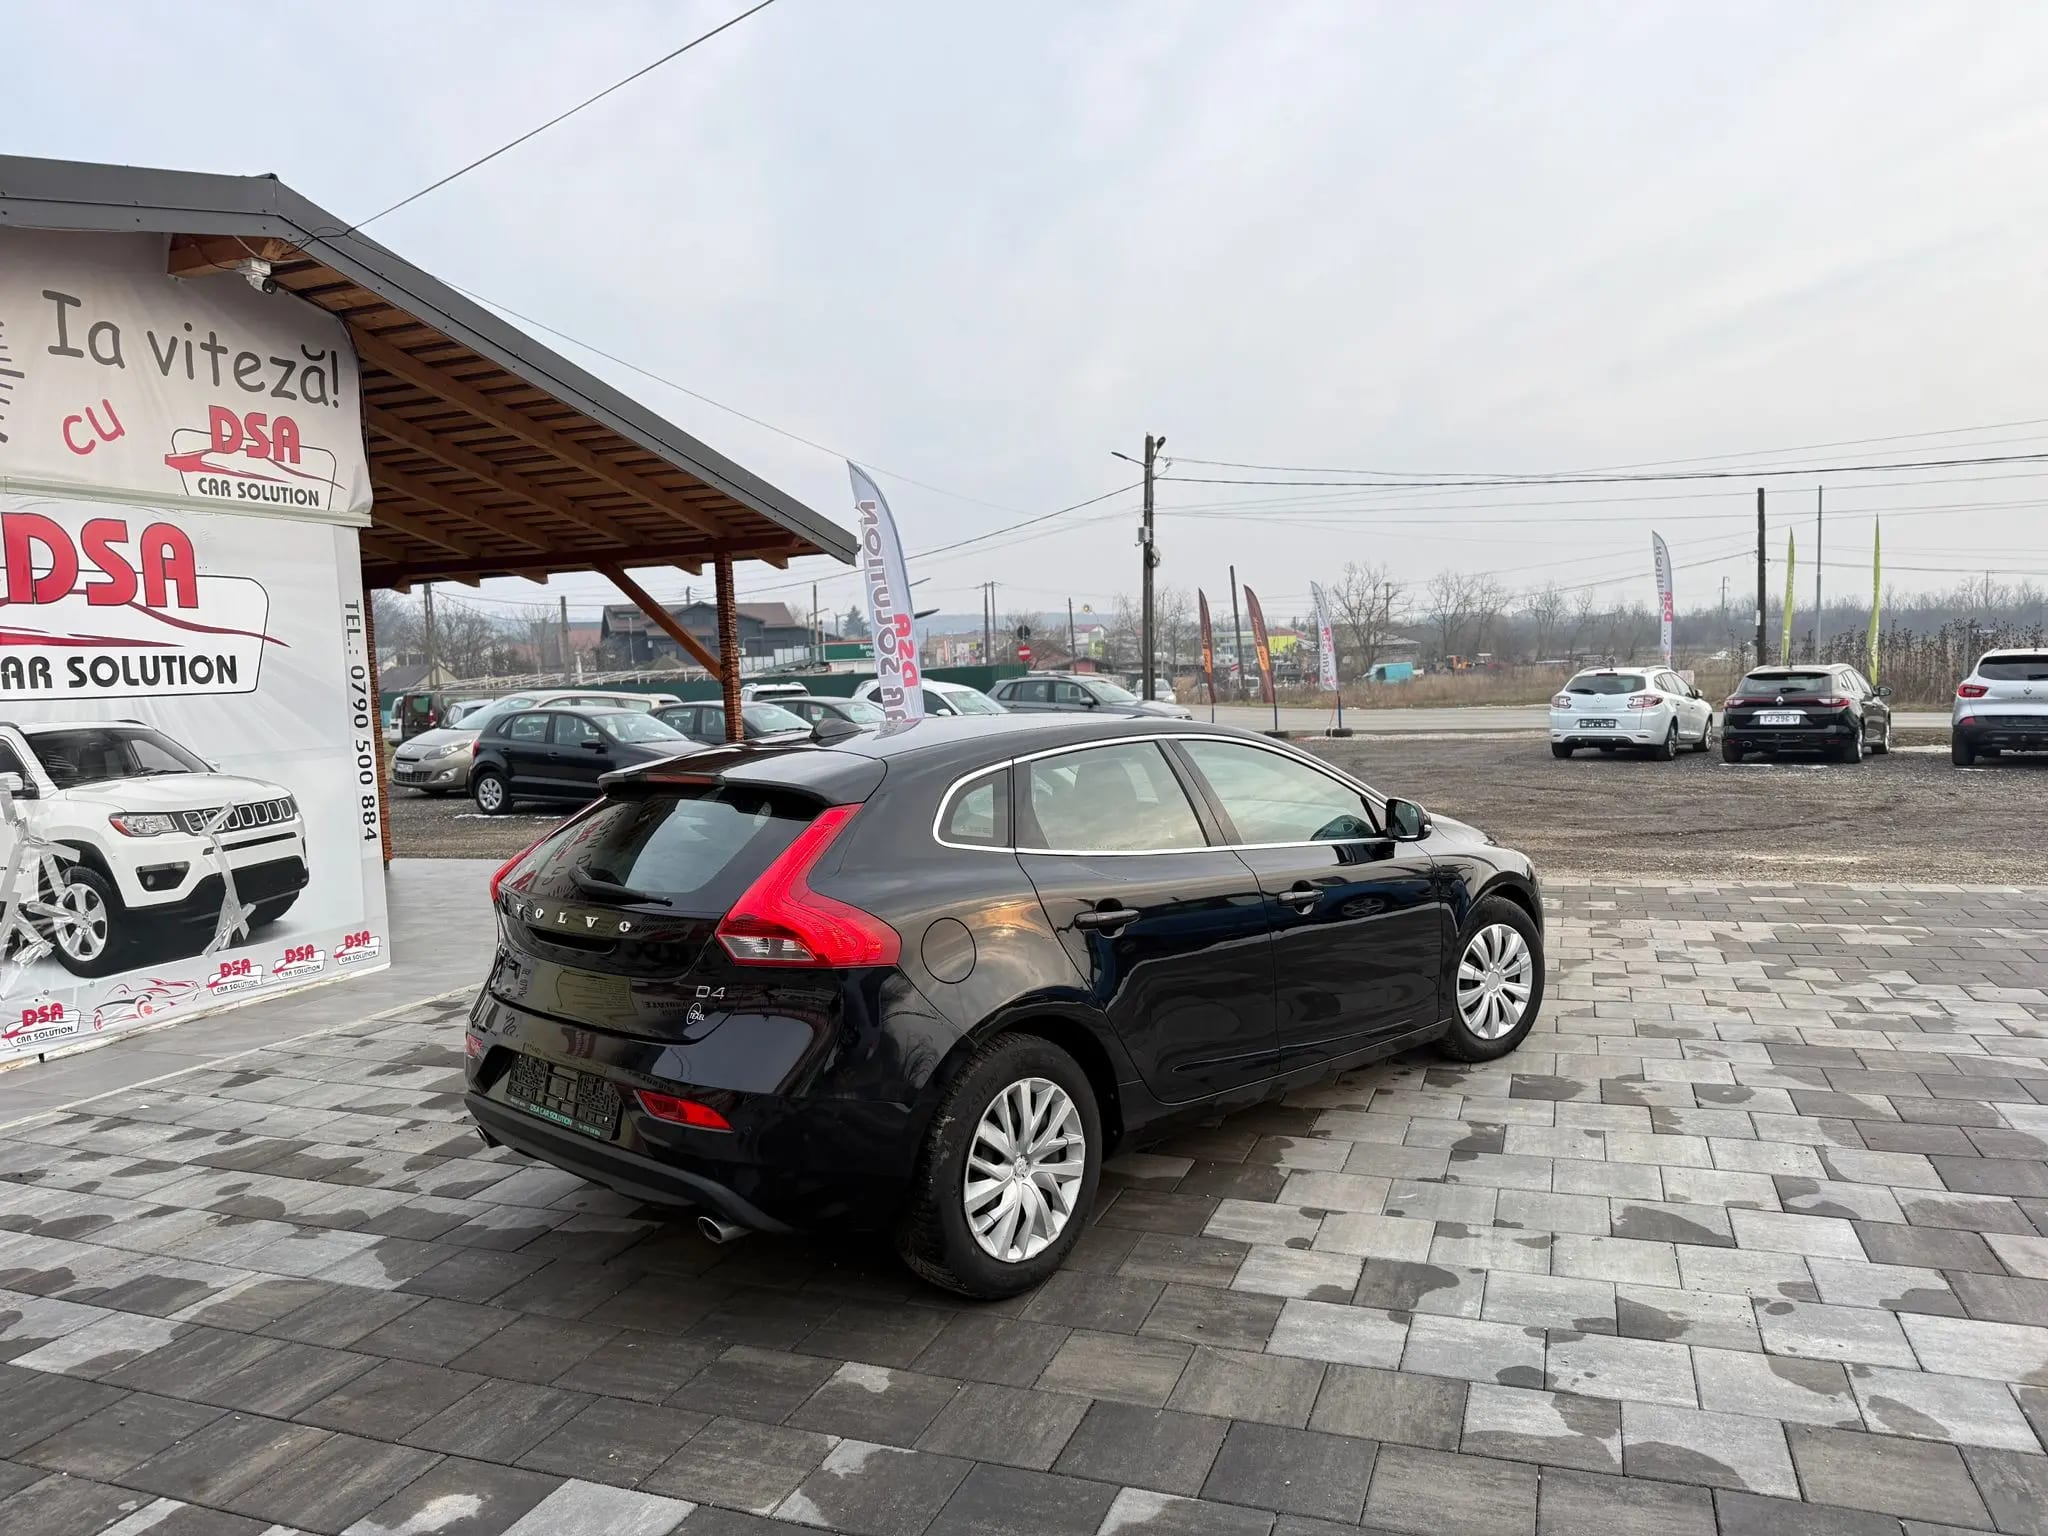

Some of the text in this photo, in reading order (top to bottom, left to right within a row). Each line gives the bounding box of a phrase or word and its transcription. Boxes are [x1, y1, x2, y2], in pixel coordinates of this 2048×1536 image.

[42, 289, 339, 408] Ia viteză!
[62, 399, 125, 455] cu
[208, 405, 300, 464] DSA
[198, 477, 319, 507] CAR SOLUTION
[1, 512, 199, 609] DSA
[1, 654, 238, 690] AR SOLUTION
[350, 665, 369, 729] 0790
[355, 740, 374, 785] 500
[361, 795, 377, 842] 884
[516, 903, 631, 933] VOLVO
[285, 944, 314, 964] DSA
[344, 930, 370, 949] DSA
[220, 958, 251, 978] DSA
[695, 985, 725, 999] D4
[22, 1003, 63, 1027] DSA
[16, 1025, 73, 1044] CAR SOLUTION
